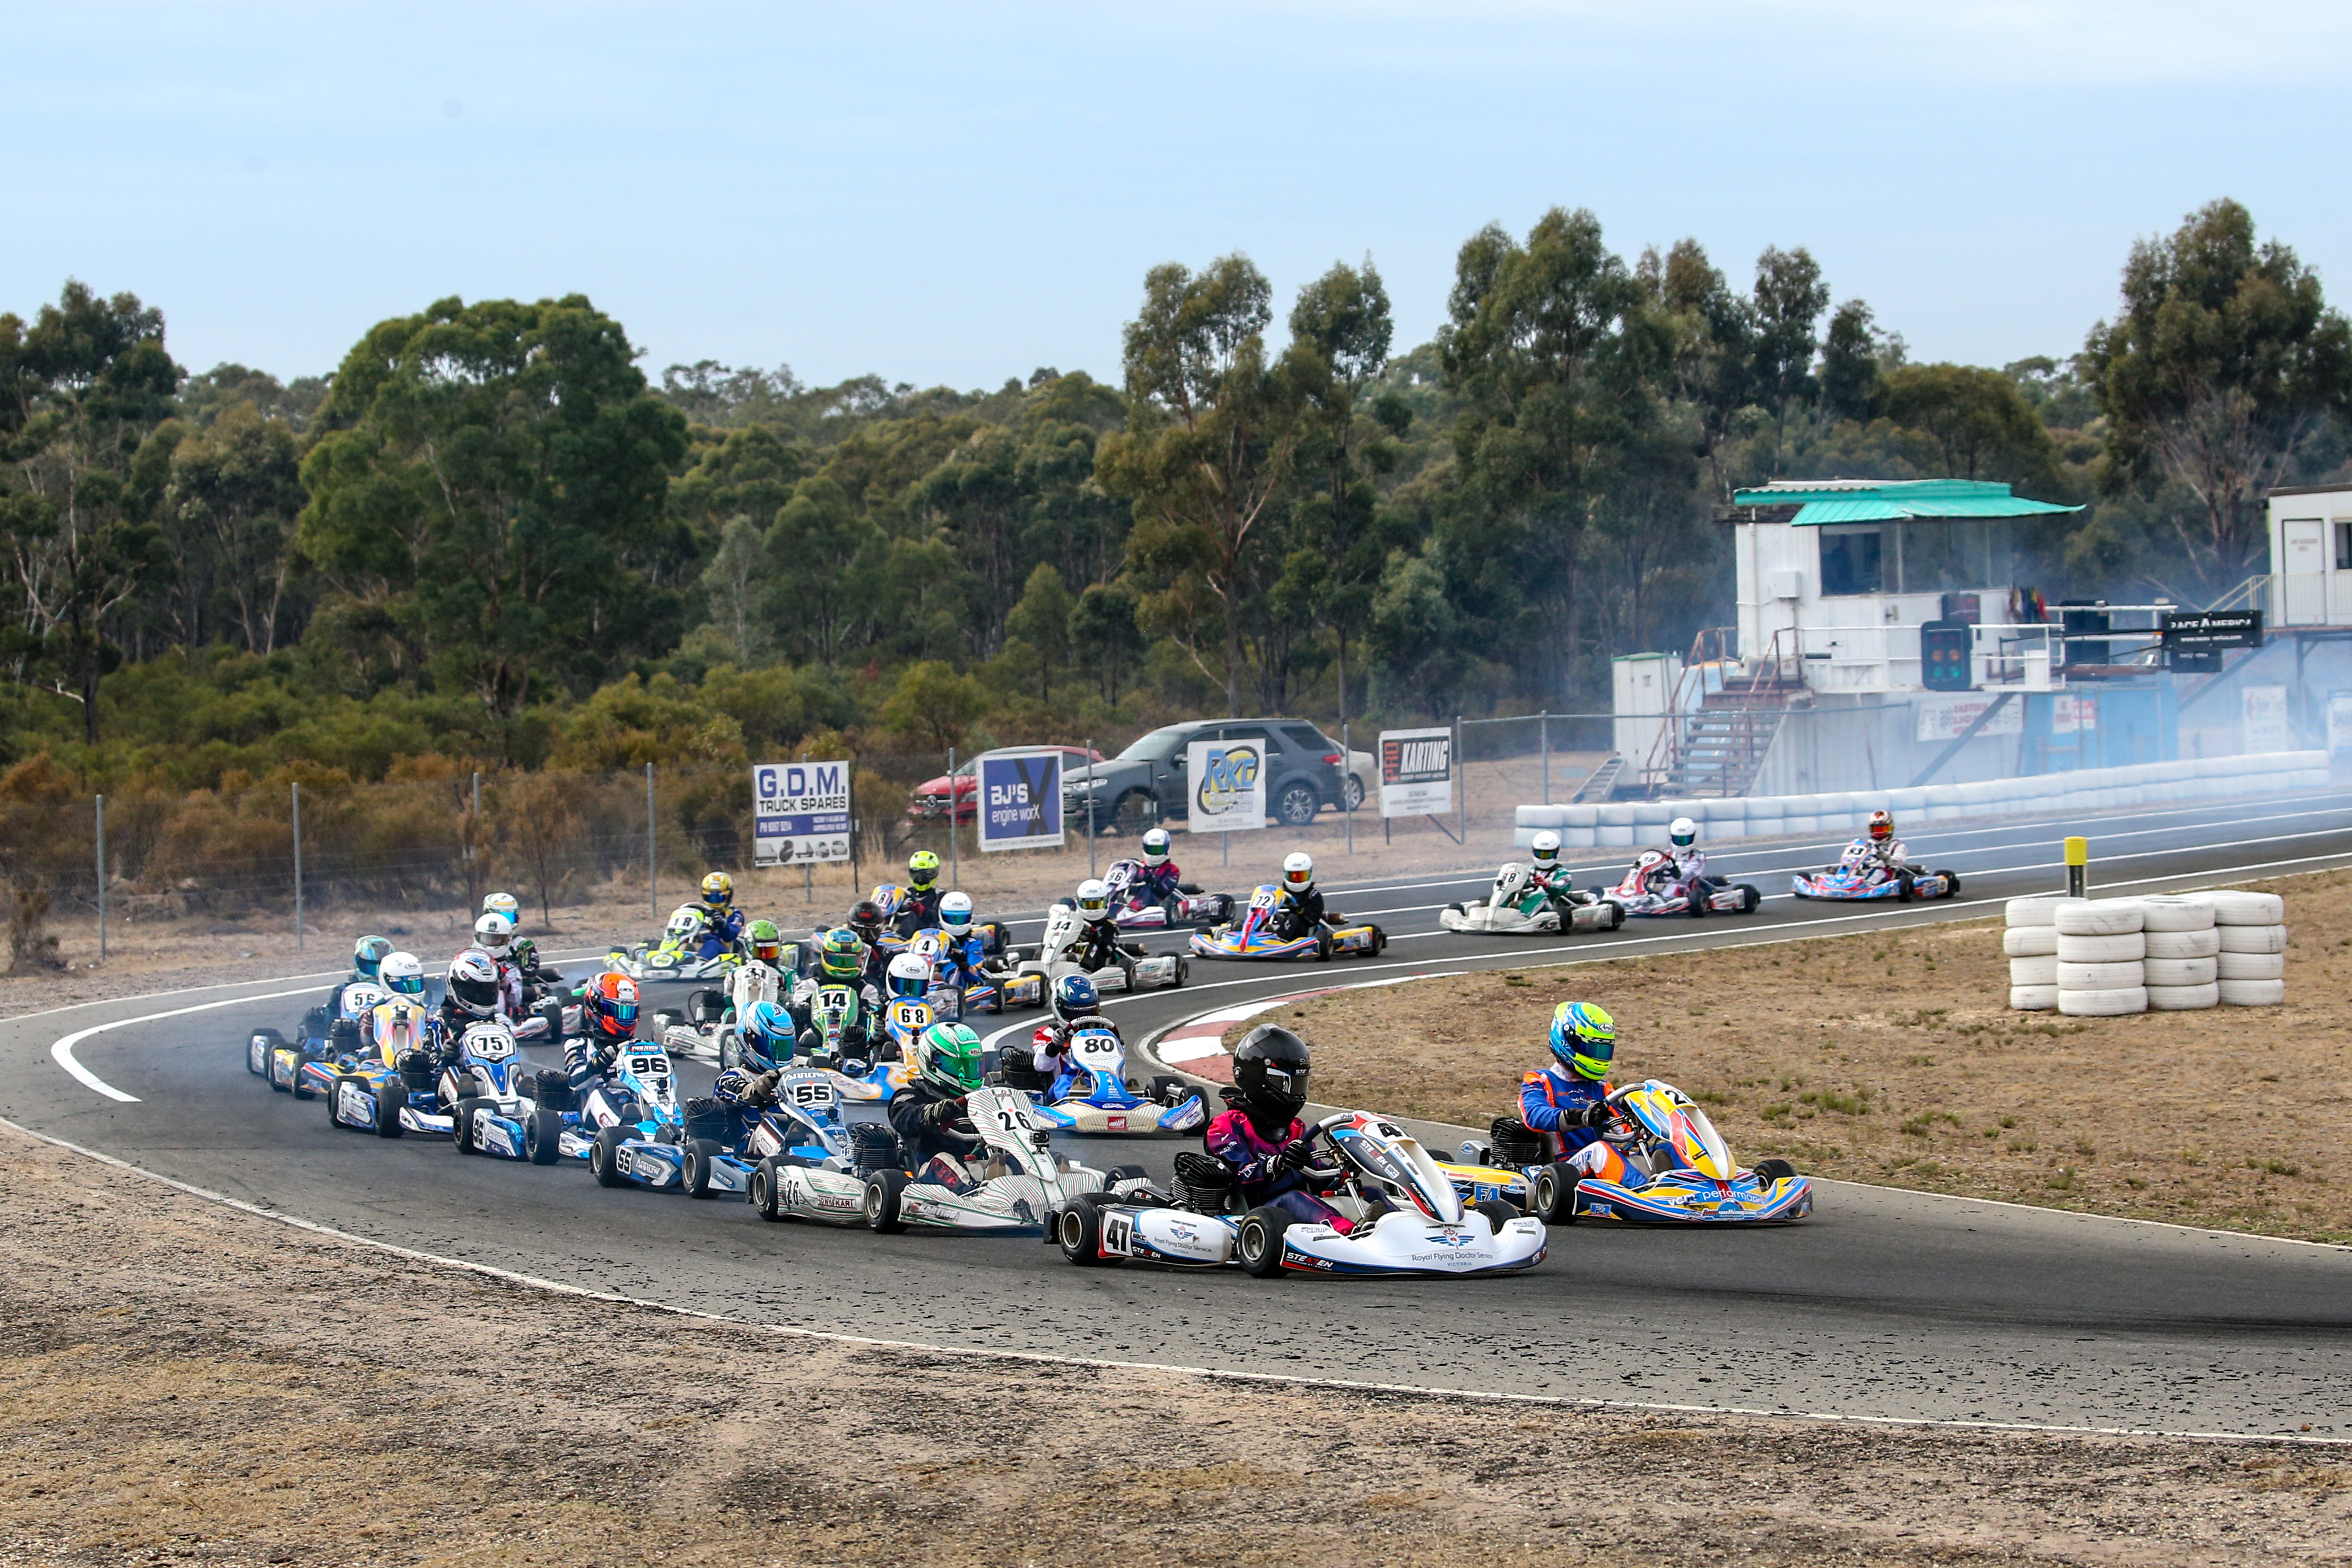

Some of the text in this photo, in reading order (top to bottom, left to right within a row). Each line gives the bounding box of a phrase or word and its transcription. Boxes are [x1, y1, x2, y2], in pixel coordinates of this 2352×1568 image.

[1384, 742, 1399, 781] PRO
[1400, 740, 1449, 774] KARTING
[1204, 748, 1257, 792] RKC
[759, 766, 846, 798] G.D.M.
[990, 783, 1029, 805] BJ'S
[759, 796, 846, 813] TRUCK SPARES
[992, 803, 1040, 826] engine worX
[1107, 872, 1123, 882] 86
[878, 893, 887, 904] 8
[1051, 920, 1073, 931] 44
[922, 940, 931, 952] 4
[820, 993, 847, 1007] 14
[901, 1008, 924, 1023] 68
[478, 1036, 503, 1052] 75
[1084, 1038, 1114, 1053] 80
[631, 1057, 668, 1074] 96
[786, 1072, 826, 1082] ARROW
[796, 1085, 830, 1103] 55
[998, 1110, 1033, 1131] 26
[617, 1149, 631, 1171] 55
[635, 1157, 661, 1176] ARROW
[785, 1178, 800, 1207] 26
[1107, 1218, 1130, 1252] 47
[1154, 1236, 1165, 1246] Royal
[1165, 1239, 1178, 1248] Flying
[1178, 1241, 1194, 1251] Doctor
[1412, 1254, 1432, 1262] Royal
[1434, 1252, 1454, 1261] Flying
[1476, 1251, 1493, 1260] Service
